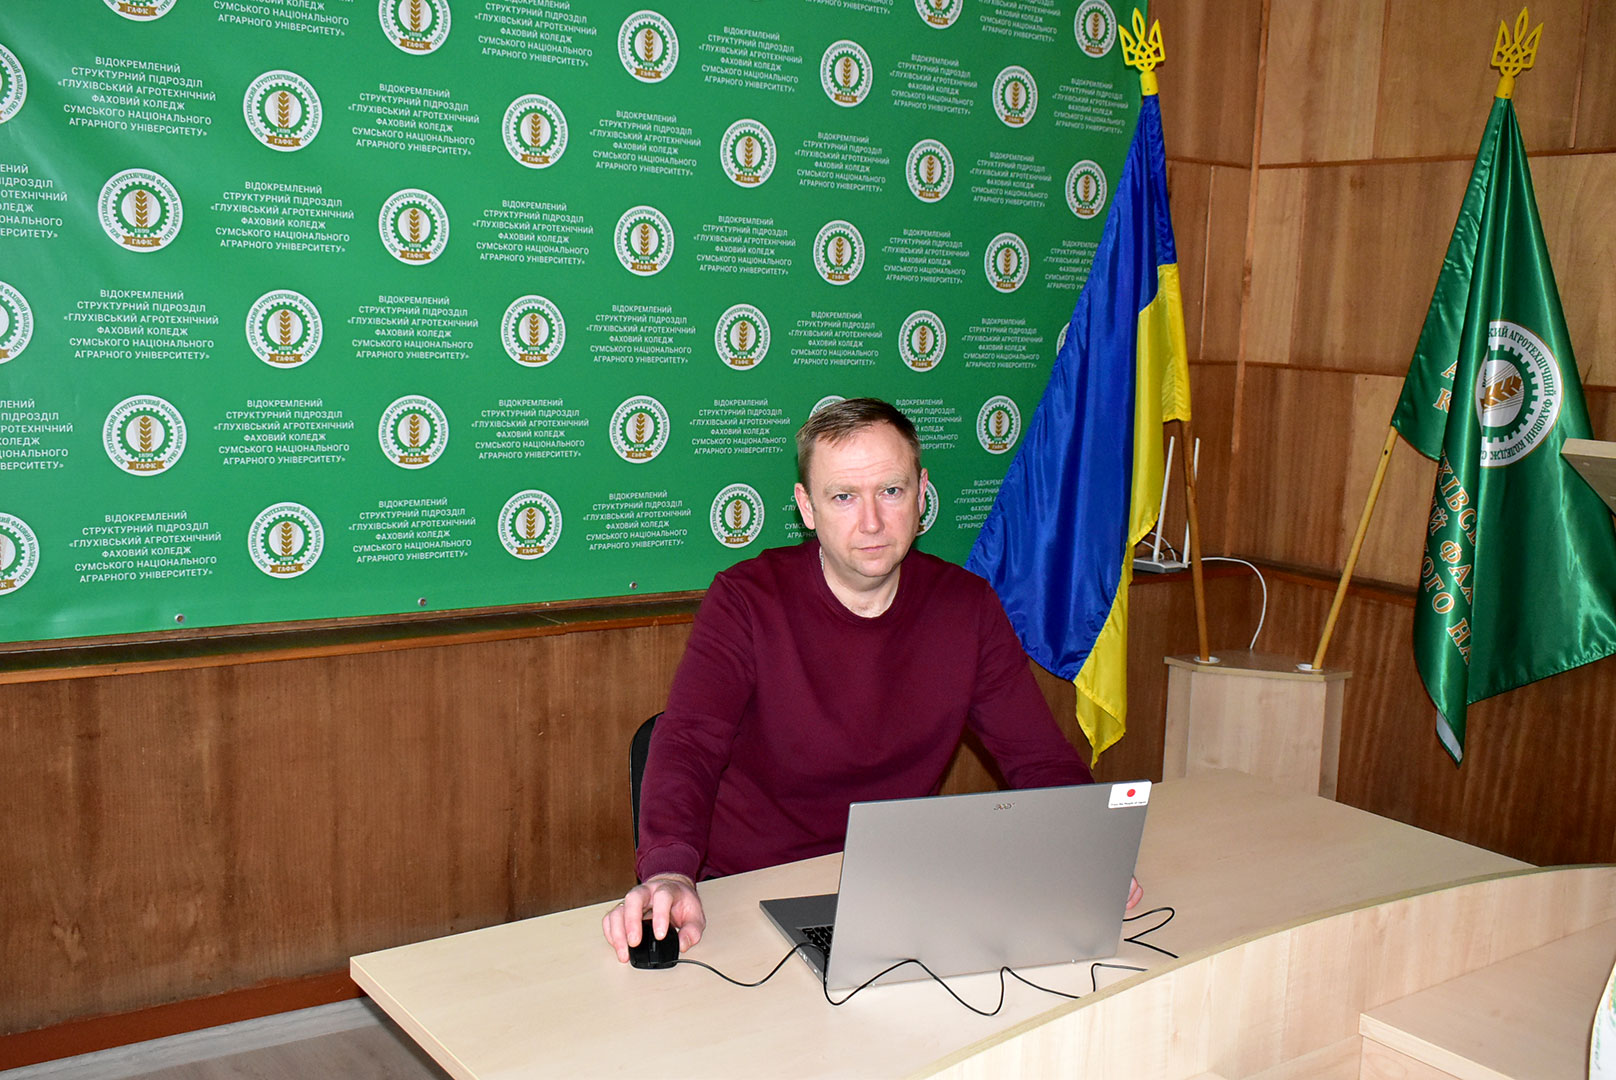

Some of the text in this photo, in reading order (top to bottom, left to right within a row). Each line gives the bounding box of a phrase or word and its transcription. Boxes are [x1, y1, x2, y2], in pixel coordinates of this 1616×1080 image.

[213, 1, 349, 26] СУМСЬКОГО НАЦІОНАЛЬНОГО
[218, 13, 345, 36] АГРАРНОГО УНІВЕРСИТЕТУ»
[724, 26, 780, 40] ВІДОКРЕМЛЕНИЙ
[708, 34, 794, 53] СТРУКТУРНИЙ ПІДРОЗДІЛ
[698, 43, 803, 63] «ГЛУХІВСЬКИЙ АГРОТЕХНІЧНИЙ
[95, 56, 180, 73] ВІДОКРЕМЛЕНИЙ
[721, 57, 781, 71] ФАХОВИЙ КОЛЕДЖ
[71, 67, 203, 88] СТРУКТУРНИЙ ПІДРОЗДІЛ
[701, 64, 799, 83] СУМСЬКОГО НАЦІОНАЛЬНОГО
[57, 78, 216, 101] «ГЛУХІВСЬКИЙ АГРОТЕХНІЧНИЙ
[704, 75, 795, 92] АГРАРНОГО УНІВЕРСИТЕТУ»
[379, 83, 450, 98] ВІДОКРЕМЛЕНИЙ
[92, 94, 184, 111] ФАХОВИЙ КОЛЕДЖ
[359, 93, 468, 112] СТРУКТУРНИЙ ПІДРОЗДІЛ
[64, 104, 212, 125] СУМСЬКОГО НАЦІОНАЛЬНОГО
[348, 103, 479, 123] «ГЛУХІВСЬКИЙ АГРОТЕХНІЧНИЙ
[69, 118, 207, 136] АГРАРНОГО УНІВЕРСИТЕТУ»
[376, 118, 453, 132] ФАХОВИЙ КОЛЕДЖ
[352, 127, 475, 145] СУМСЬКОГО НАЦІОНАЛЬНОГО
[356, 139, 471, 155] АГРАРНОГО УНІВЕРСИТЕТУ»
[245, 181, 322, 194] ВІДОКРЕМЛЕНИЙ
[223, 192, 342, 208] СТРУКТУРНИЙ ПІДРОЗДІЛ
[502, 200, 567, 211] ВІДОКРЕМЛЕНИЙ
[210, 203, 354, 219] «ГЛУХІВСЬКИЙ АГРОТЕХНІЧНИЙ
[483, 209, 584, 224] СТРУКТУРНИЙ ПІДРОЗДІЛ
[241, 217, 325, 230] ФАХОВИЙ КОЛЕДЖ
[472, 220, 594, 234] «ГЛУХІВСЬКИЙ АГРОТЕХНІЧНИЙ
[215, 227, 350, 242] СУМСЬКОГО НАЦІОНАЛЬНОГО
[498, 233, 569, 243] ФАХОВИЙ КОЛЕДЖ
[220, 239, 345, 252] АГРАРНОГО УНІВЕРСИТЕТУ»
[476, 242, 589, 255] СУМСЬКОГО НАЦІОНАЛЬНОГО
[480, 253, 585, 264] АГРАРНОГО УНІВЕРСИТЕТУ»
[100, 289, 184, 300] ВІДОКРЕМЛЕНИЙ
[77, 301, 206, 313] СТРУКТУРНИЙ ПІДРОЗДІЛ
[612, 305, 672, 313] ВІДОКРЕМЛЕНИЙ
[64, 313, 219, 324] «ГЛУХІВСЬКИЙ АГРОТЕХНІЧНИЙ
[596, 314, 687, 325] СТРУКТУРНИЙ ПІДРОЗДІЛ
[811, 311, 862, 319] ВІДОКРЕМЛЕНИЙ
[97, 325, 188, 337] ФАХОВИЙ КОЛЕДЖ
[586, 324, 696, 334] «ГЛУХІВСЬКИЙ АГРОТЕХНІЧНИЙ
[842, 322, 875, 330] ПІДРОЗДІЛ
[69, 338, 214, 348] СУМСЬКОГО НАЦІОНАЛЬНОГО
[644, 336, 673, 344] КОЛЕДЖ
[75, 350, 210, 360] АГРАРНОГО УНІВЕРСИТЕТУ»
[634, 346, 692, 354] НАЦІОНАЛЬНОГО
[791, 348, 827, 356] СУМСЬКОГО
[594, 355, 688, 364] АГРАРНОГО УНІВЕРСИТЕТУ»
[1508, 330, 1557, 396] АГРОТЕХНІЧНИЙ
[247, 398, 323, 408] ВІДОКРЕМЛЕНИЙ
[1, 412, 60, 422] ПІДРОЗДІЛ
[226, 410, 343, 419] СТРУКТУРНИЙ ПІДРОЗДІЛ
[214, 420, 354, 431] «ГЛУХІВСЬКИЙ АГРОТЕХНІЧНИЙ
[1526, 398, 1553, 445] ФАХОВИЙ
[289, 433, 326, 441] КОЛЕДЖ
[218, 444, 350, 454] СУМСЬКОГО НАЦІОНАЛЬНОГО
[223, 455, 345, 465] АГРАРНОГО УНІВЕРСИТЕТУ»
[379, 497, 447, 509] ВІДОКРЕМЛЕНИЙ
[105, 510, 187, 523] ВІДОКРЕМЛЕНИЙ
[359, 508, 465, 520] СТРУКТУРНИЙ ПІДРОЗДІЛ
[82, 522, 208, 535] СТРУКТУРНИЙ ПІДРОЗДІЛ
[348, 517, 476, 531] «ГЛУХІВСЬКИЙ АГРОТЕХНІЧНИЙ
[69, 532, 221, 547] «ГЛУХІВСЬКИЙ АГРОТЕХНІЧНИЙ
[375, 530, 450, 540] ФАХОВИЙ КОЛЕДЖ
[102, 546, 191, 558] ФАХОВИЙ КОЛЕДЖ
[353, 539, 472, 553] СУМСЬКОГО НАЦІОНАЛЬНОГО
[356, 550, 468, 563] АГРАРНОГО УНІВЕРСИТЕТУ»
[75, 556, 217, 571] СУМСЬКОГО НАЦІОНАЛЬНОГО
[80, 568, 212, 583] АГРАРНОГО УНІВЕРСИТЕТУ»
